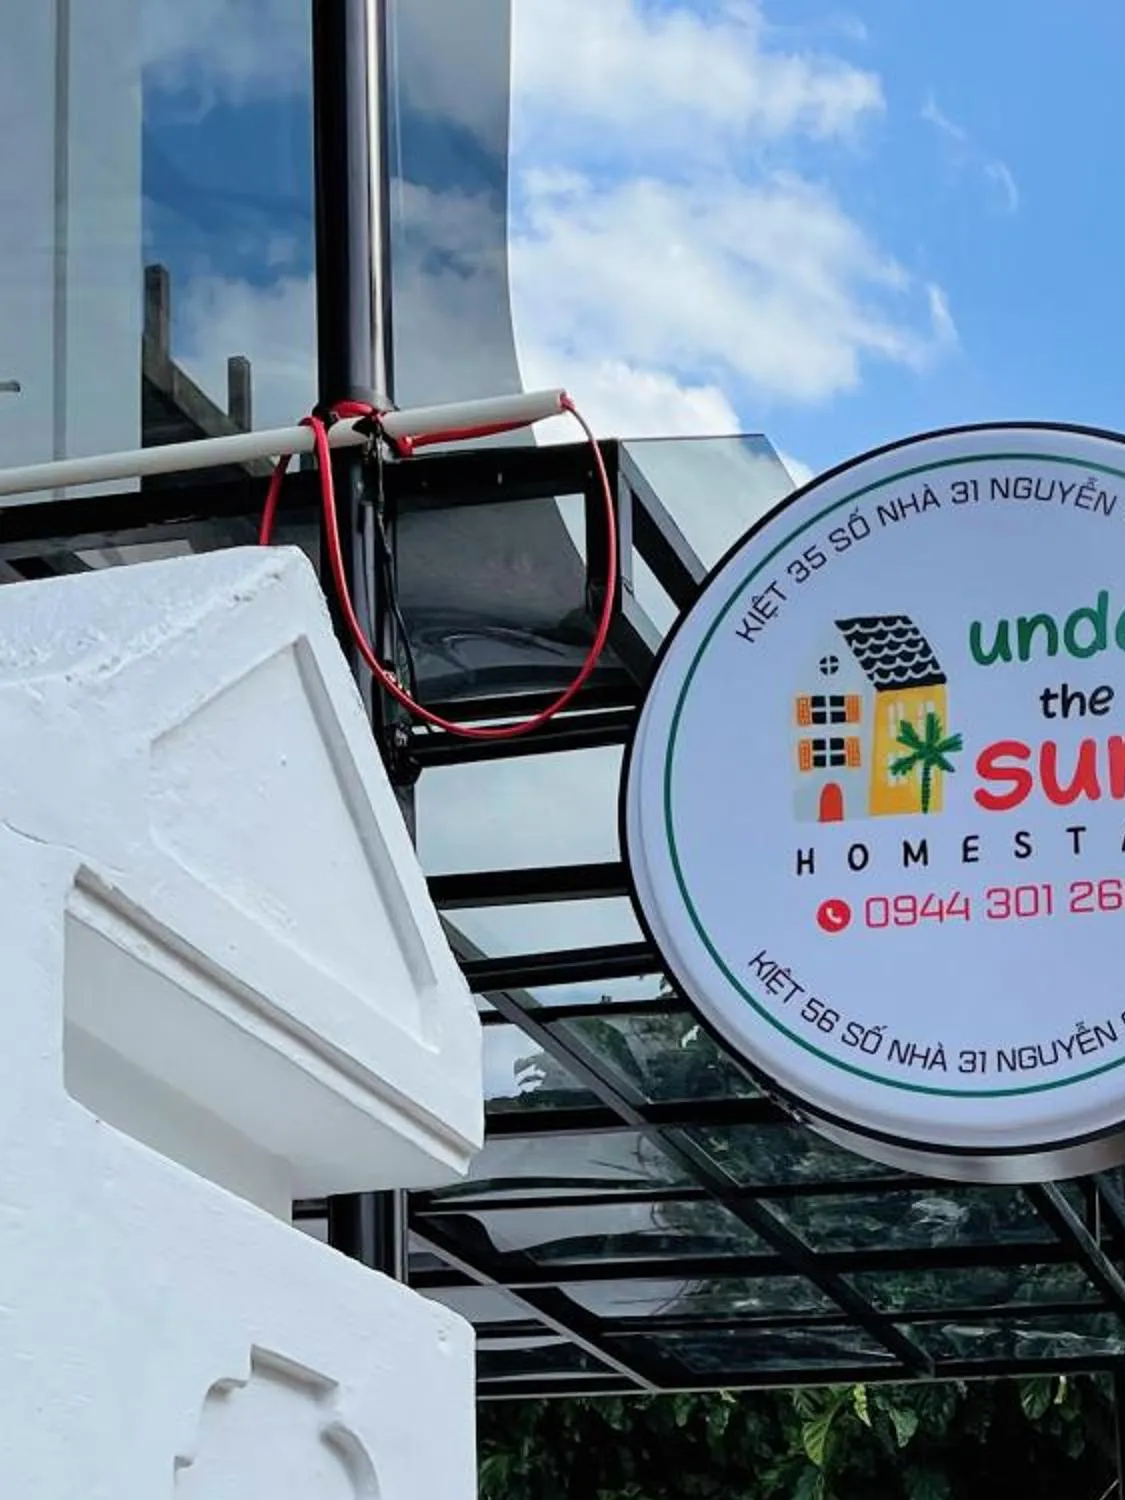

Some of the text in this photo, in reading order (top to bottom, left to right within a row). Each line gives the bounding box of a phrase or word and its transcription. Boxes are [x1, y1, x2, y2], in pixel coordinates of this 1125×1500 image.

[734, 580, 788, 644] KIỆT
[787, 544, 828, 585] 35
[828, 506, 872, 553] SỐ
[876, 483, 942, 527] NHÀ
[950, 479, 980, 505] 31
[989, 477, 1118, 517] NGUYỄN
[1039, 683, 1115, 719] the
[864, 891, 971, 929] 0944
[985, 884, 1053, 919] 301
[748, 949, 805, 1004] KIỆT
[800, 997, 839, 1034] 56
[841, 1021, 888, 1056] SỐ
[887, 1039, 948, 1072] NHÀ
[957, 1050, 987, 1074] 31
[996, 1020, 1119, 1073] NGUYỄN
